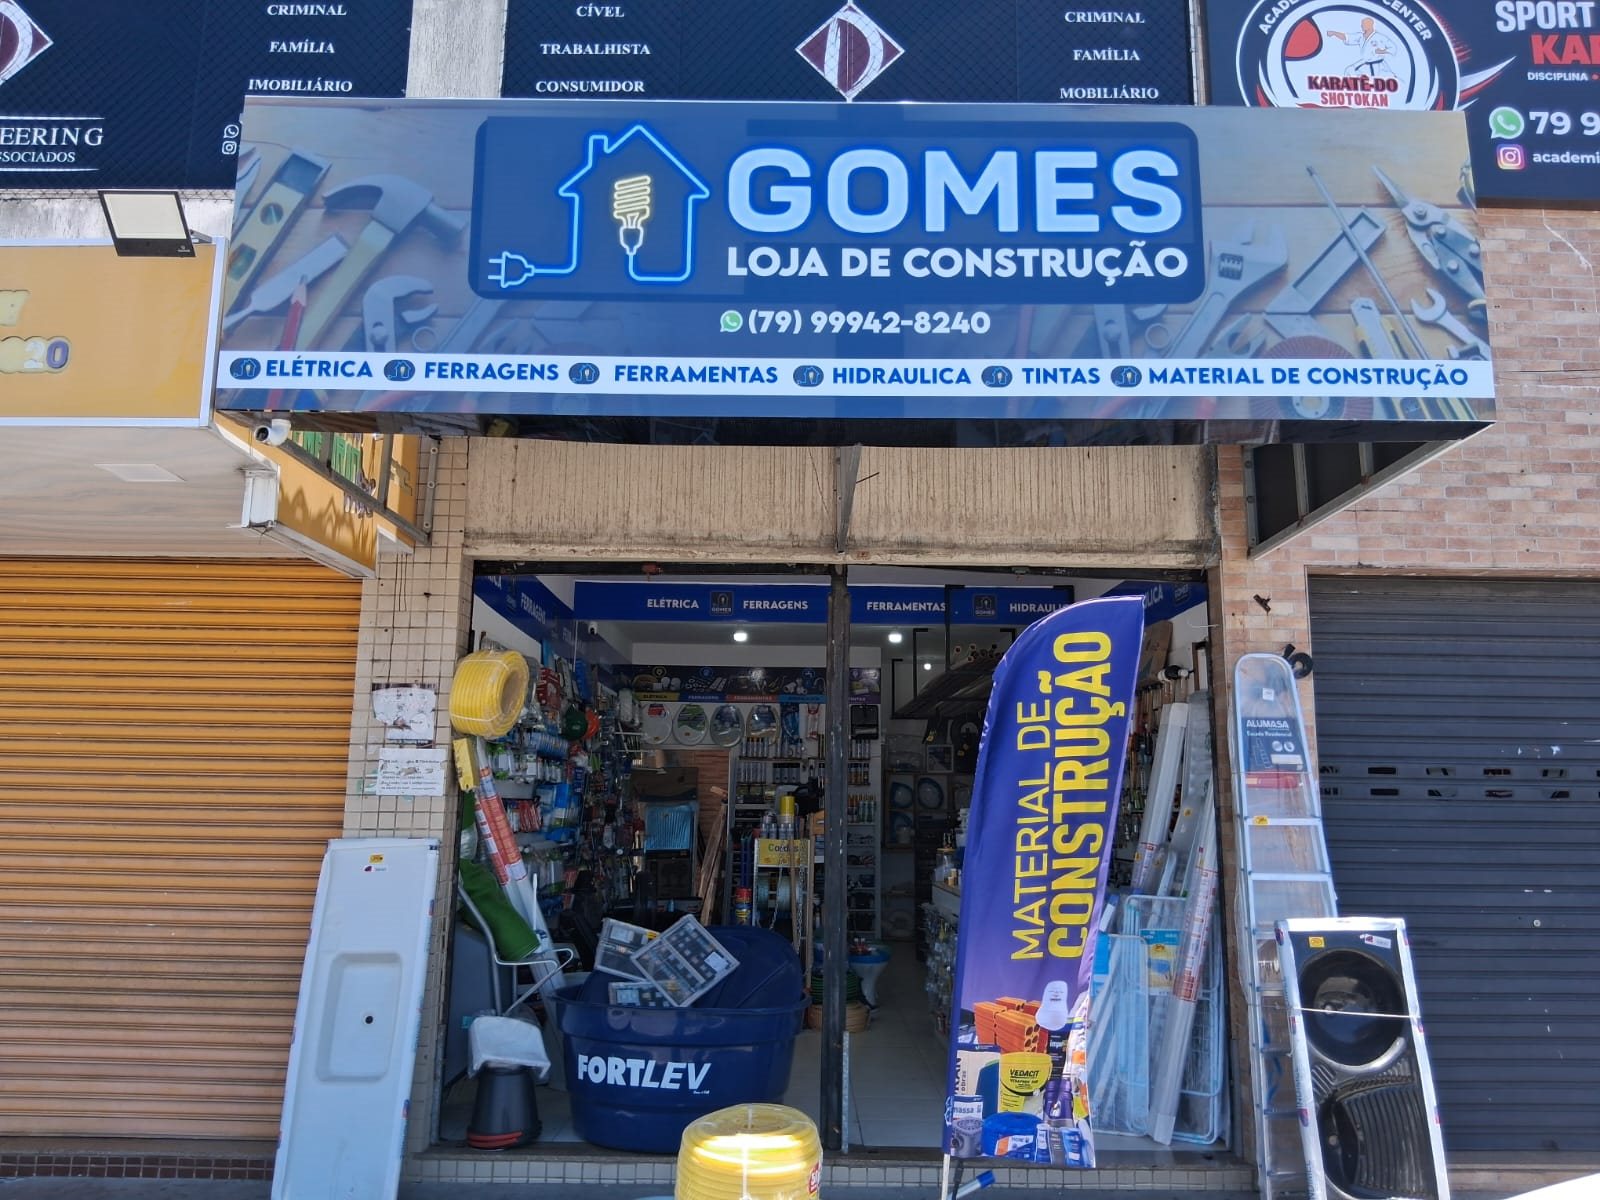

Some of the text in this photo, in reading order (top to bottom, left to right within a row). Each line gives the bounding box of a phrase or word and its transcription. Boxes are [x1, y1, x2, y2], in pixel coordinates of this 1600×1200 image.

[267, 4, 347, 16] CRIMINAL
[576, 3, 625, 18] CÍVEL
[1064, 11, 1145, 23] CRIMINAL
[1495, 0, 1595, 32] SPORT
[270, 39, 335, 54] FAMÍLIA
[540, 43, 651, 55] TRABALHISTA
[1073, 47, 1140, 61] FAMÍLIA
[248, 77, 353, 92] IMOBILIÁRIO
[1307, 74, 1398, 92] KARATÊ-DO
[1527, 72, 1588, 82] DISCIPLINA
[535, 80, 645, 93] CONSUMIDOR
[1320, 92, 1389, 107] SHOTOKAN
[1529, 111, 1571, 135] 79
[1533, 151, 1600, 164] academi
[727, 147, 1183, 233] GOMES
[727, 240, 1188, 286] LOJA DE CONSTRUÇÃO
[748, 309, 991, 335] (79) 99942-8240
[266, 355, 373, 378] ELÉTRICA
[424, 361, 559, 382] FERRAGENS
[614, 364, 778, 384] FERRAMENTAS
[833, 367, 972, 385] HIDRAULICA
[1022, 367, 1101, 384] TINTAS
[1149, 364, 1469, 390] MATERIAL DE CONSTRUÇÃO
[647, 596, 699, 609] ELÉTRICA
[743, 600, 808, 610] FERRAGENS
[866, 601, 946, 612] FERRAMENTAS
[1246, 719, 1289, 729] ALUMASA
[1038, 631, 1126, 959] CONSTRUÇÃO
[1011, 700, 1050, 960] MATERIAL DE
[578, 1054, 712, 1090] FORTLEV
[1010, 1069, 1040, 1077] VEDACIT
